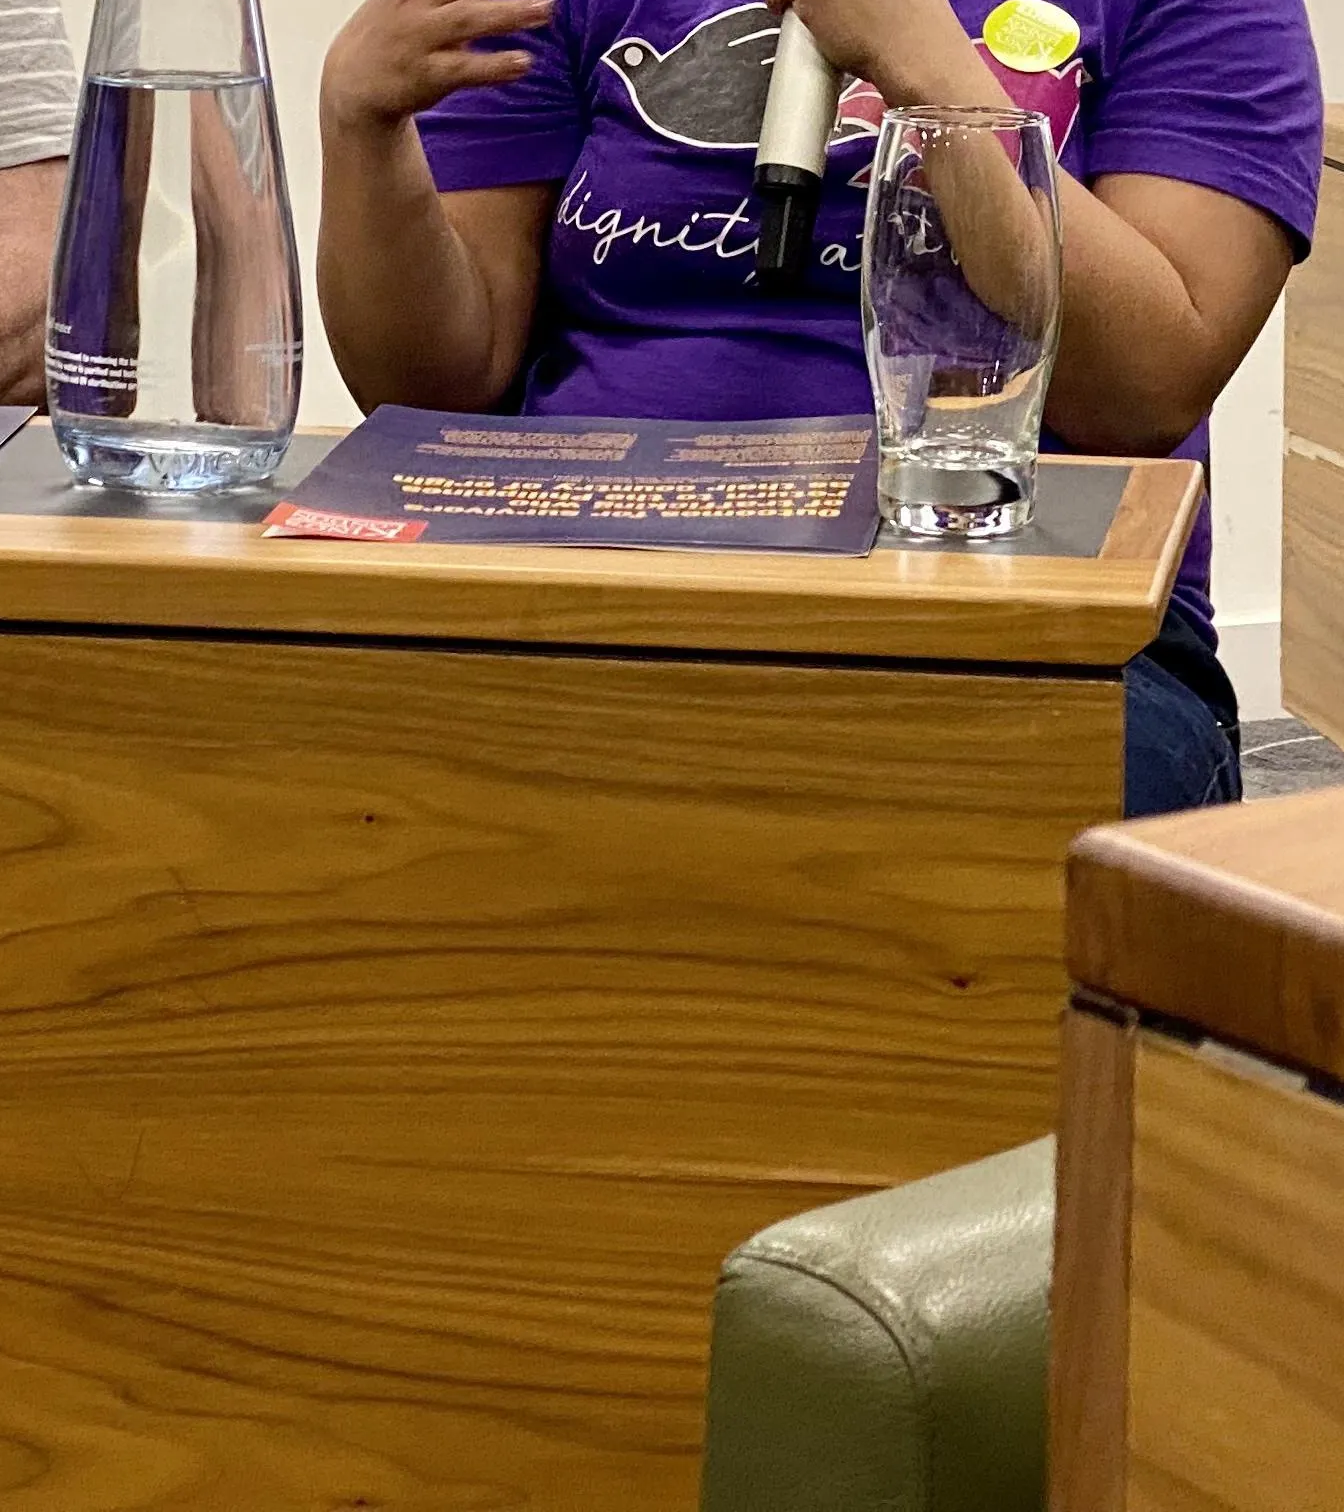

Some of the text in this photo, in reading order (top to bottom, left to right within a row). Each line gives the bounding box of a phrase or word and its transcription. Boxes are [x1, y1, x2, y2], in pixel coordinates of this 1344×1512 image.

[393, 474, 495, 488] origin
[502, 481, 542, 490] of
[807, 480, 851, 489] as
[552, 482, 696, 492] country
[706, 482, 795, 492] their
[401, 484, 847, 502] return to the Philippines
[508, 499, 844, 510] of trafficking who
[403, 503, 840, 519] Outcomes for survivors
